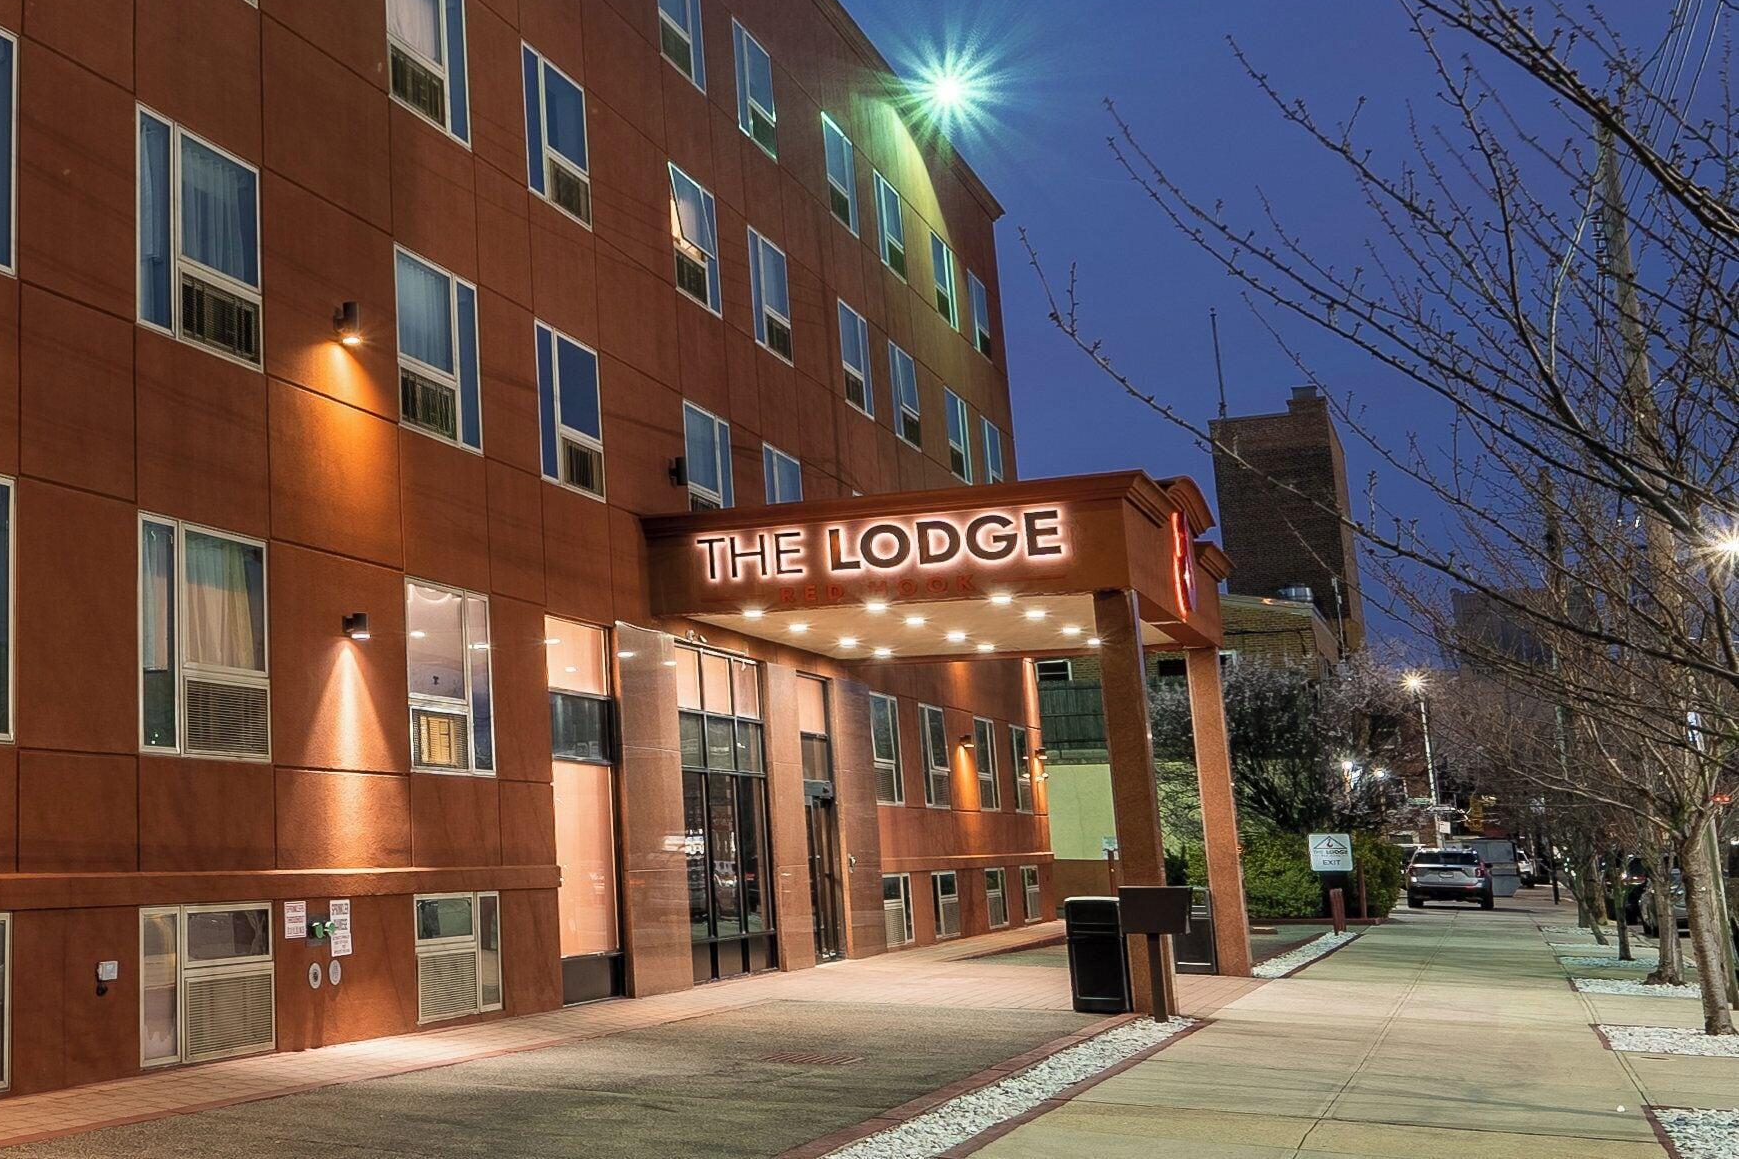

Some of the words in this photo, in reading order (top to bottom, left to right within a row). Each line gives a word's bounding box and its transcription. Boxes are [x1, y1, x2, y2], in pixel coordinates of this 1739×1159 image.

[696, 531, 803, 580] THE
[828, 509, 1062, 572] LODGE
[779, 583, 845, 604] RED
[866, 574, 976, 596] HOOK
